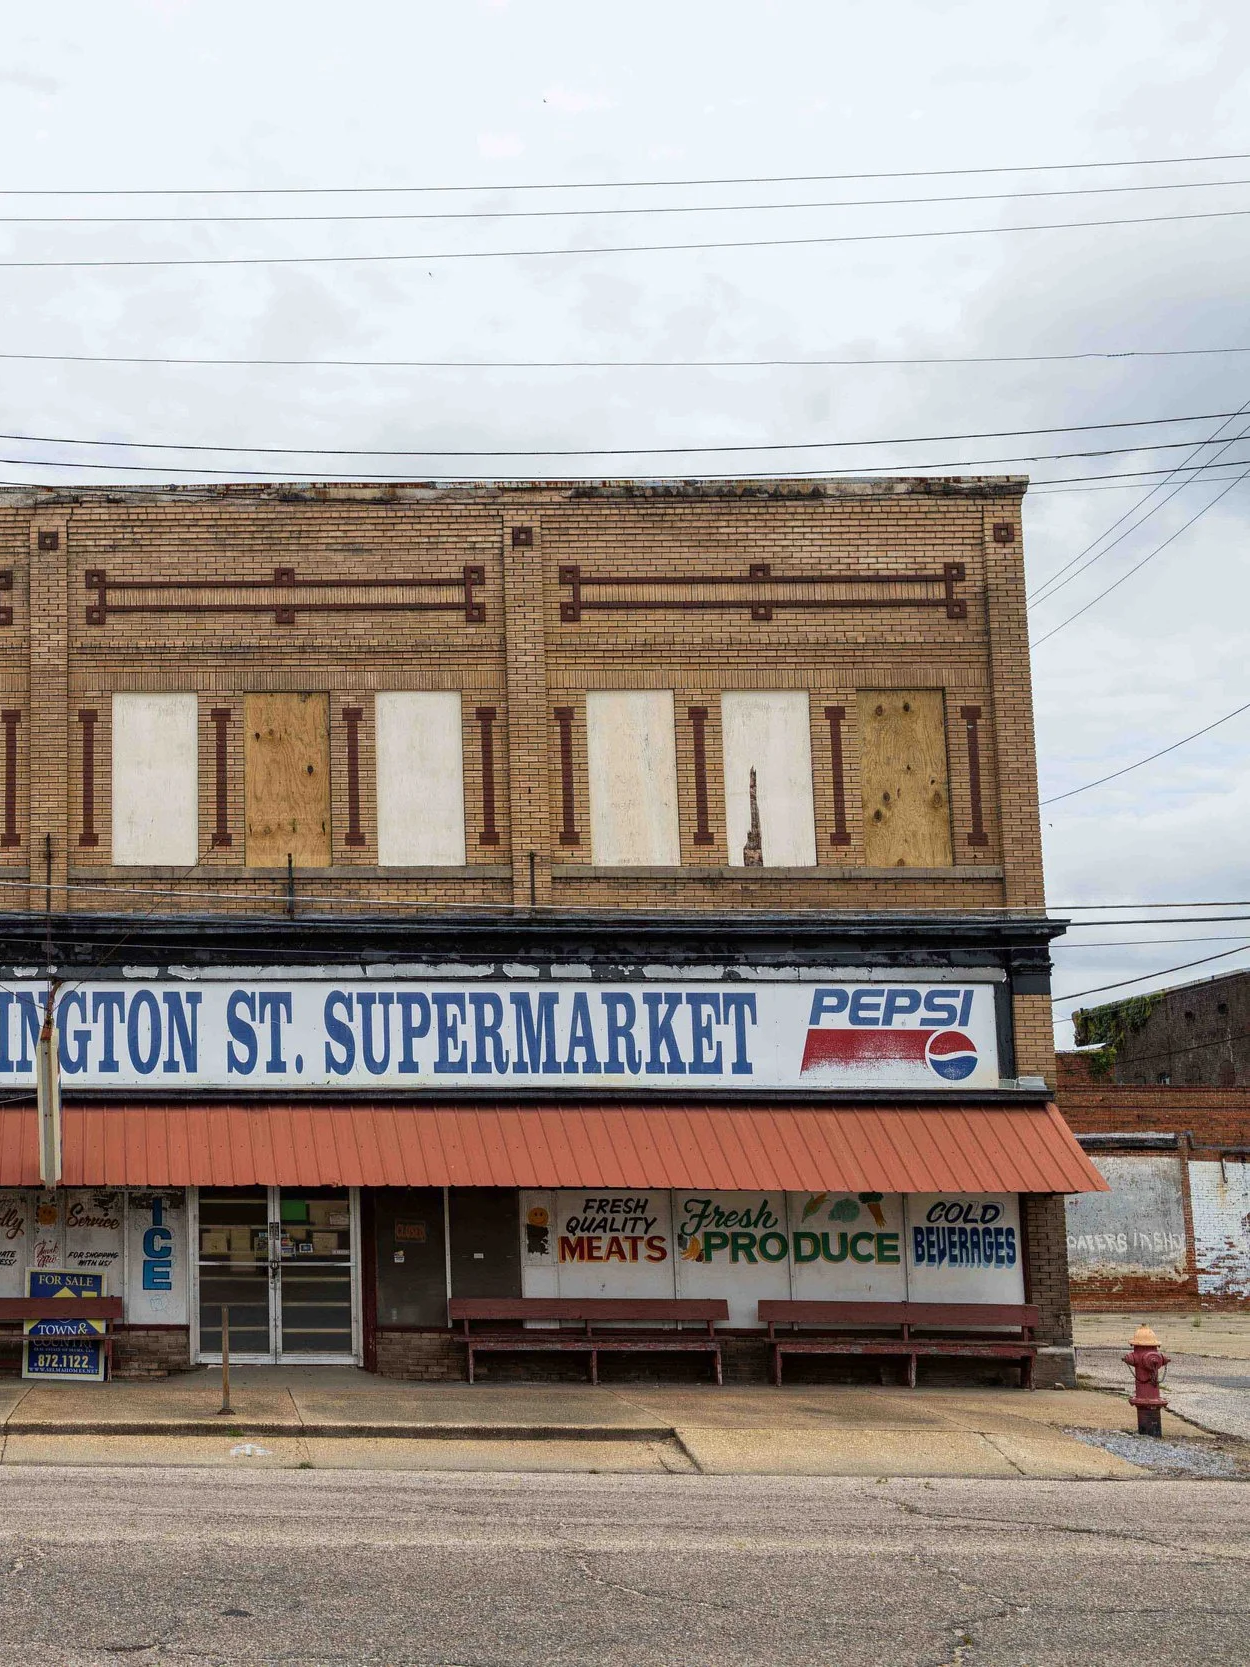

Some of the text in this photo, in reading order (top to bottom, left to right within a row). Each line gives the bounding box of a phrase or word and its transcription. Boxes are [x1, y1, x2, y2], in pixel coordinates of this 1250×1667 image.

[808, 988, 975, 1027] PEPSI
[226, 989, 304, 1076] ST.
[324, 989, 758, 1076] SUPERMARKET
[66, 1203, 120, 1230] Service
[583, 1198, 649, 1215] FRESH
[680, 1198, 779, 1237] Fresh
[925, 1201, 1002, 1225] COLD
[565, 1216, 658, 1235] QUALITY
[84, 1251, 119, 1259] SHOPPING
[142, 1198, 172, 1291] ICE
[558, 1235, 668, 1264] MEATS
[702, 1231, 901, 1265] PRODUCE
[912, 1226, 1017, 1269] BEVERAGES
[39, 1275, 94, 1287] FOR SALE
[37, 1354, 89, 1368] 872.1122
